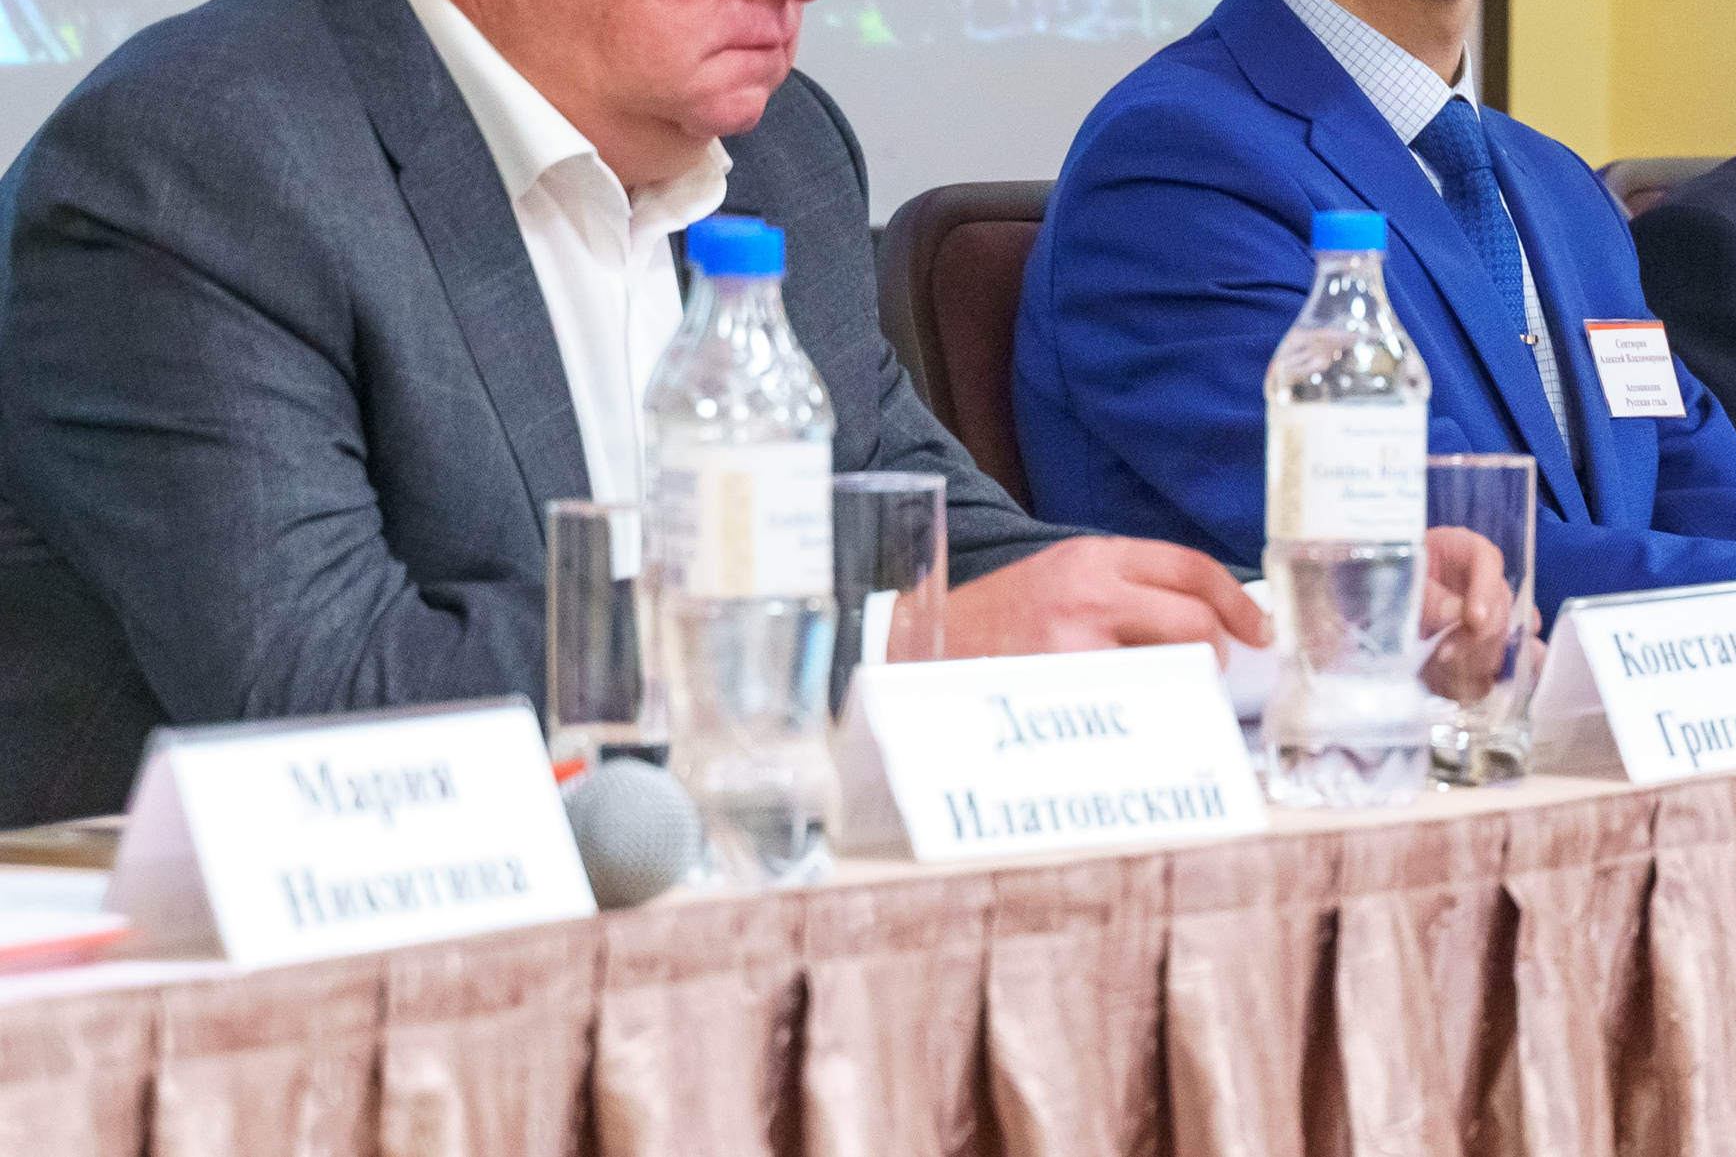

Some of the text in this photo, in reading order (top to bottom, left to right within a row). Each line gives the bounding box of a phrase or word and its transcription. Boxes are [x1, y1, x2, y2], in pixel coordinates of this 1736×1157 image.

[985, 692, 1132, 754] Денис
[286, 757, 459, 829] Мария
[943, 769, 1228, 841] Илатовский
[278, 854, 532, 929] Никитина
